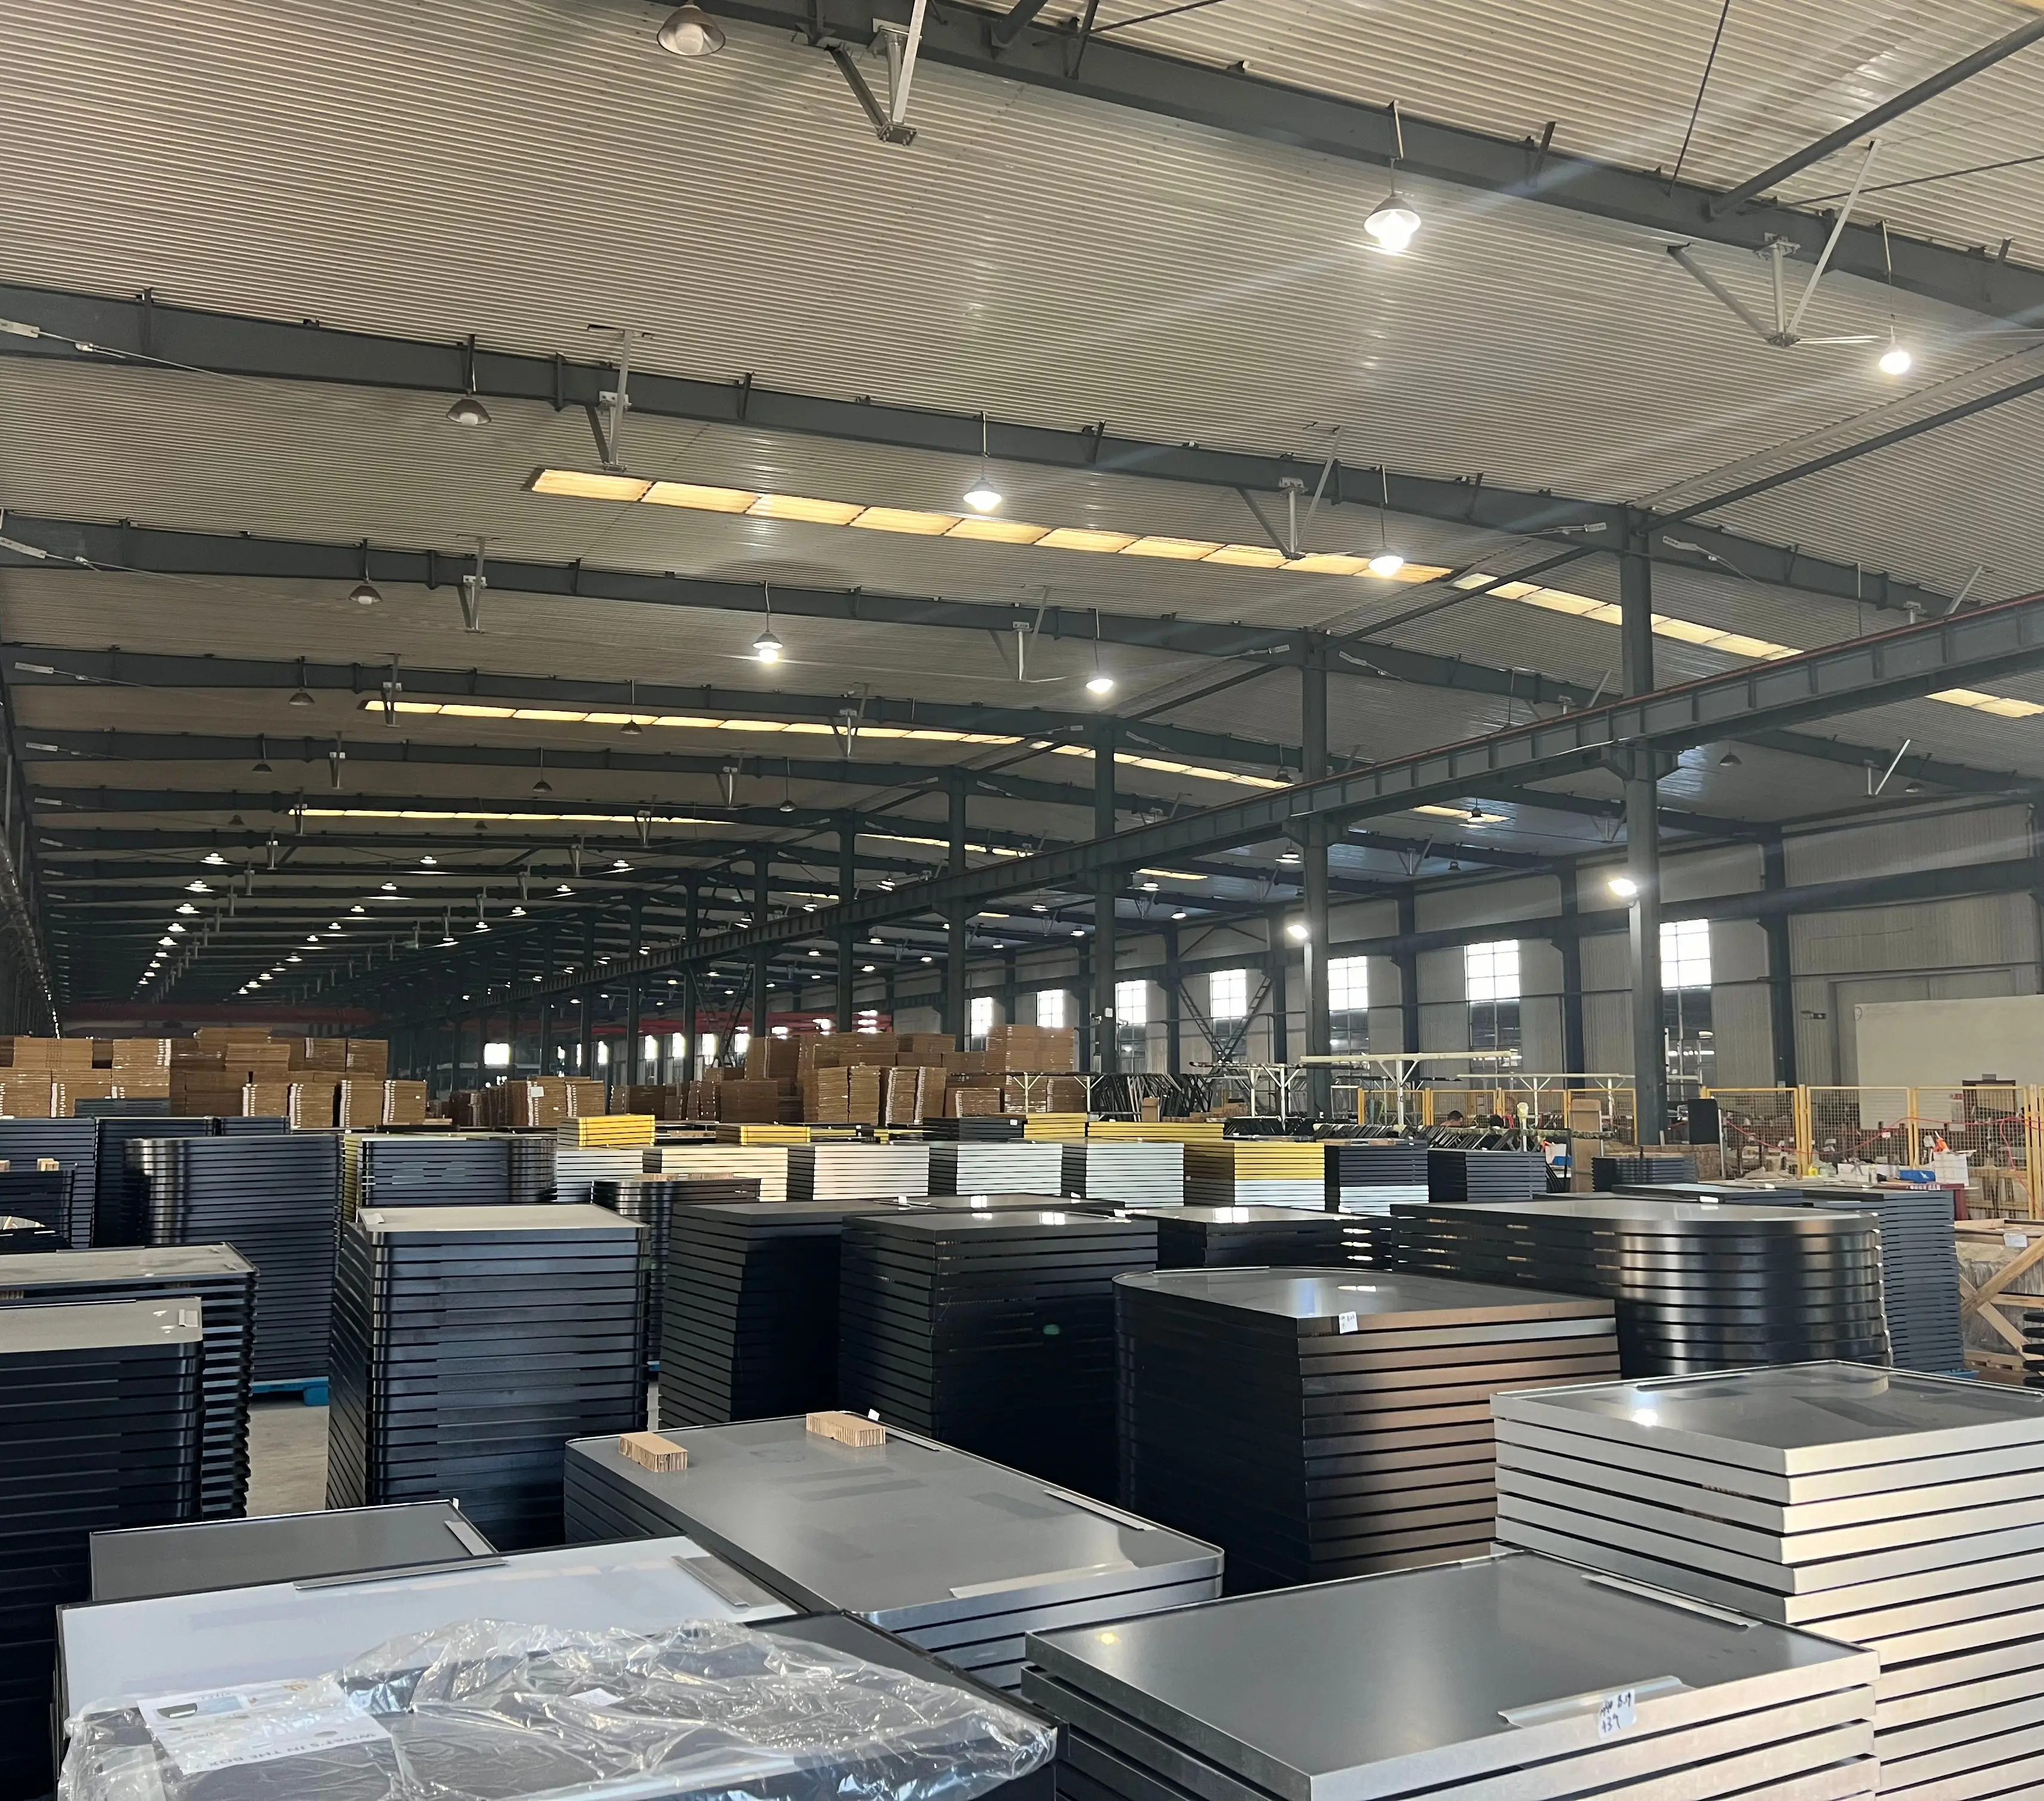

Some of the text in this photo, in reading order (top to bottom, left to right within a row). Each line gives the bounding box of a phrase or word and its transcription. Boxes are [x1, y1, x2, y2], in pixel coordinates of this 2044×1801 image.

[309, 1733, 376, 1747] WHAT'S
[249, 1750, 282, 1759] THE
[209, 1756, 244, 1766] BOX
